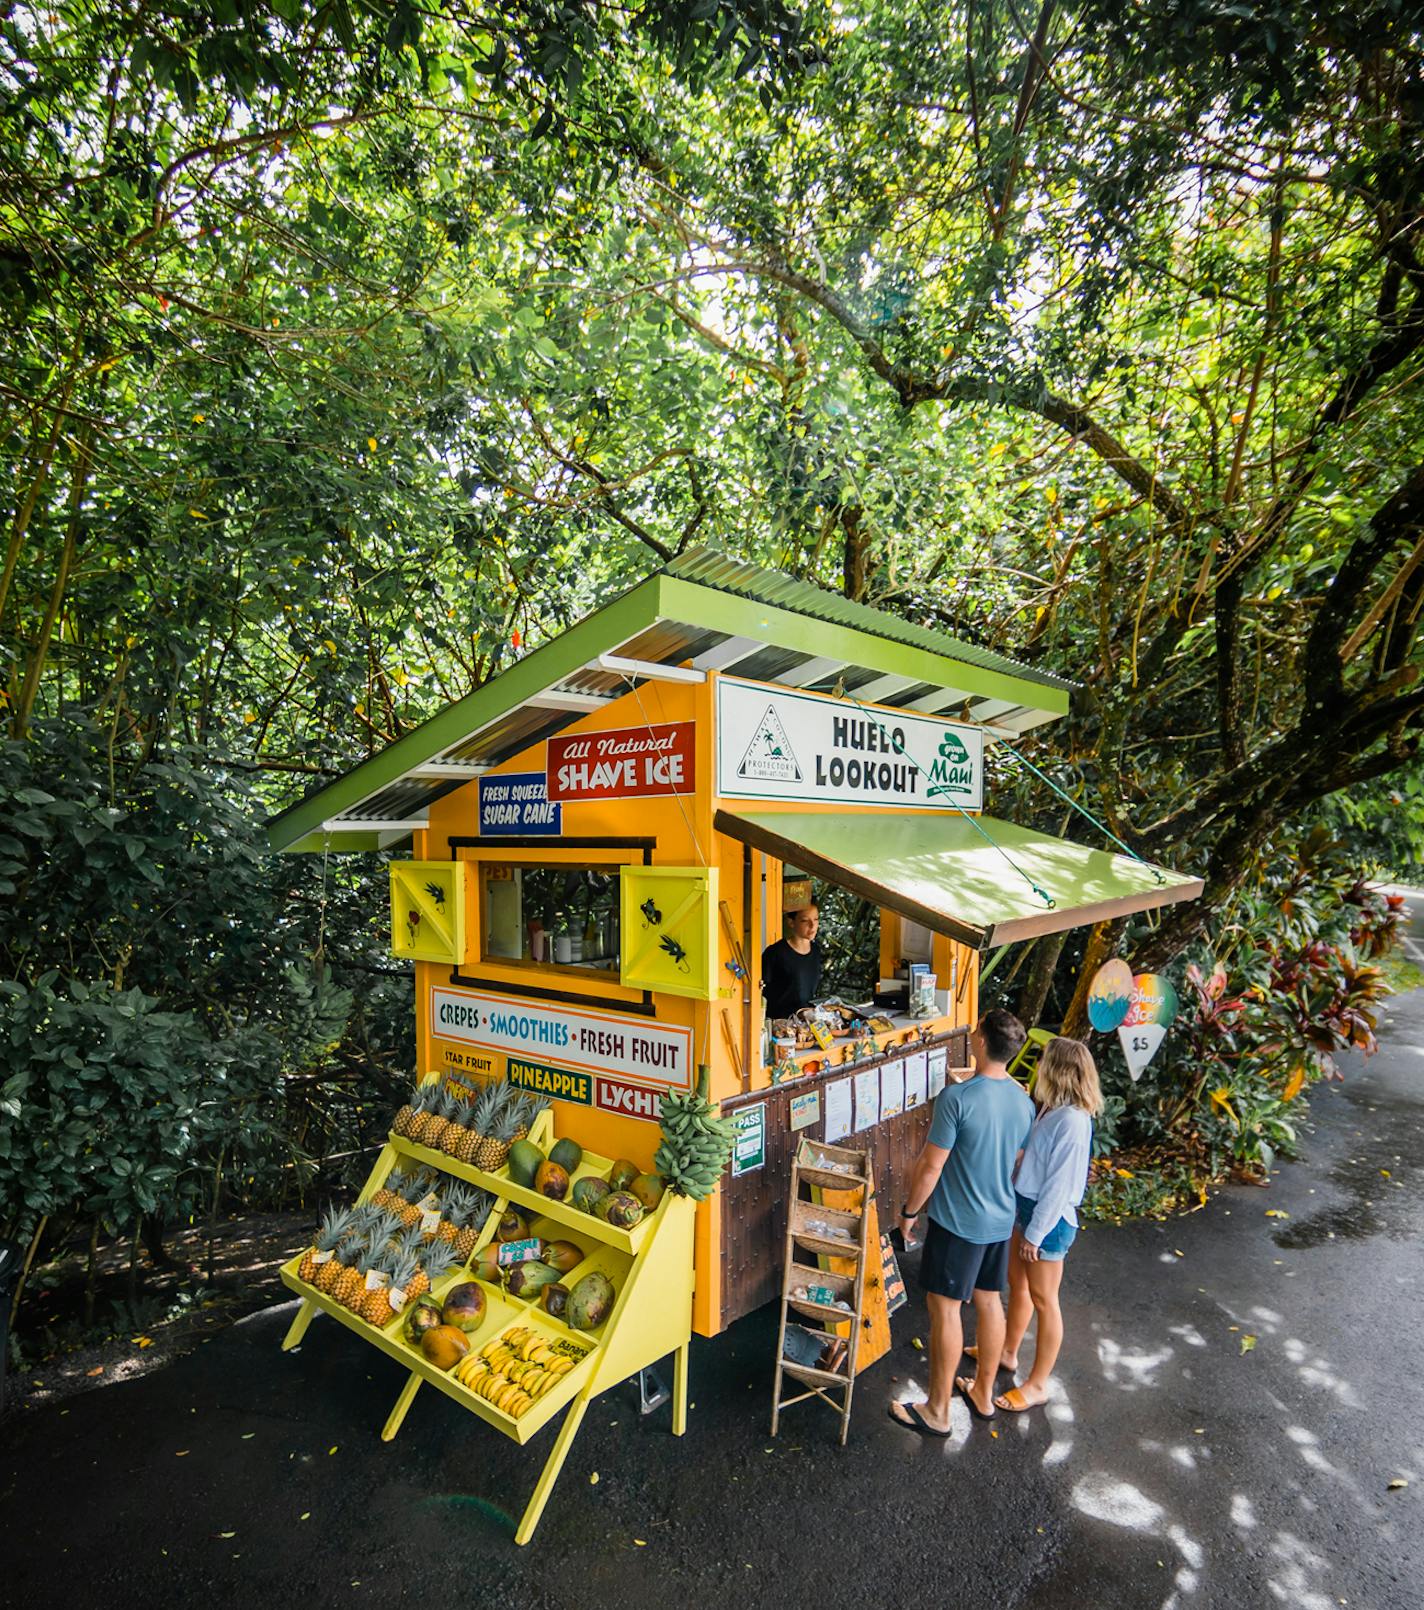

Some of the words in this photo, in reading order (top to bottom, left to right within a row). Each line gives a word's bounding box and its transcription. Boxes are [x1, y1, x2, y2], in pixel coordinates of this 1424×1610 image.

[563, 741, 591, 759] All
[597, 731, 677, 756] Natural
[833, 716, 905, 755] HUELO
[558, 758, 637, 792] SHAVE
[645, 754, 685, 786] ICE
[748, 760, 794, 770] PROTECTORS
[816, 754, 919, 793] LOOKOUT
[928, 758, 973, 784] Maui
[482, 785, 510, 802] FRESH
[483, 803, 521, 825] SUGAR
[523, 803, 557, 824] CANE
[440, 1003, 479, 1029] CREPES
[490, 1012, 569, 1047] SMOOTHIES
[580, 1028, 625, 1059] FRESH
[632, 1038, 679, 1069] FRUIT
[445, 1051, 463, 1065] STAR
[466, 1056, 492, 1071] FRUIT
[511, 1063, 587, 1099] PINEAPPLE
[738, 1113, 761, 1129] PASS
